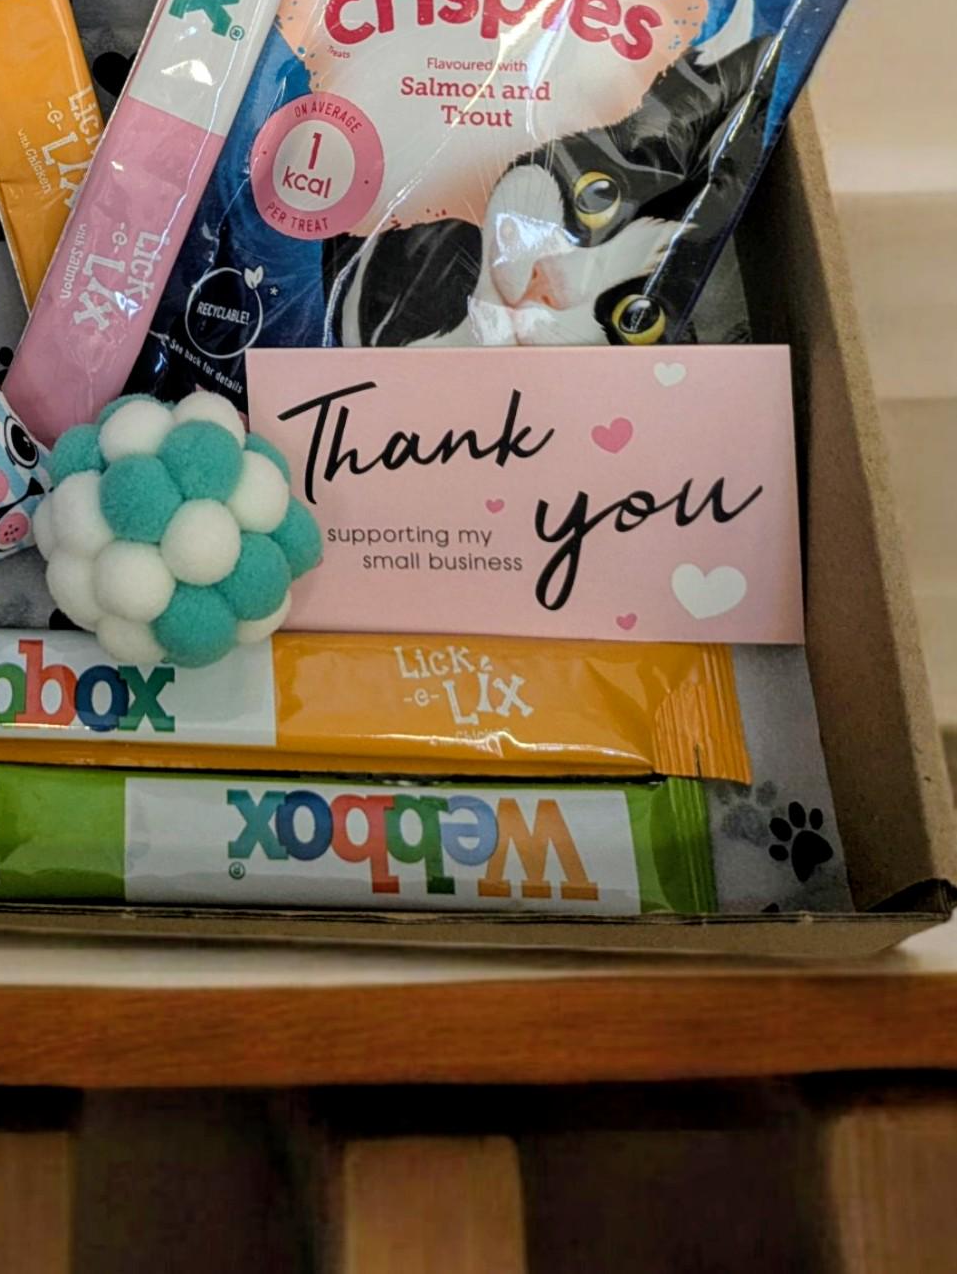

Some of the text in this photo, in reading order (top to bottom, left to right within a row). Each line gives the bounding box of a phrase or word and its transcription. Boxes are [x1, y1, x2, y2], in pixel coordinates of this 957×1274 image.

[427, 57, 528, 72] Flavoured with
[401, 77, 551, 101] Salmon and
[295, 101, 363, 134] ON AVERAGE
[441, 105, 513, 127] Trout
[308, 132, 322, 170] 1
[26, 148, 52, 195] Chicken
[282, 166, 332, 199] kcal
[265, 201, 329, 233] PER TREAT
[60, 246, 84, 299] Salmon
[196, 301, 251, 326] RECYCLABLE!
[170, 338, 243, 394] See back for details
[277, 381, 555, 505] Thank
[327, 526, 492, 549] supporting my
[533, 476, 763, 611] you
[363, 552, 523, 571] small business
[226, 789, 599, 900] Webbox
